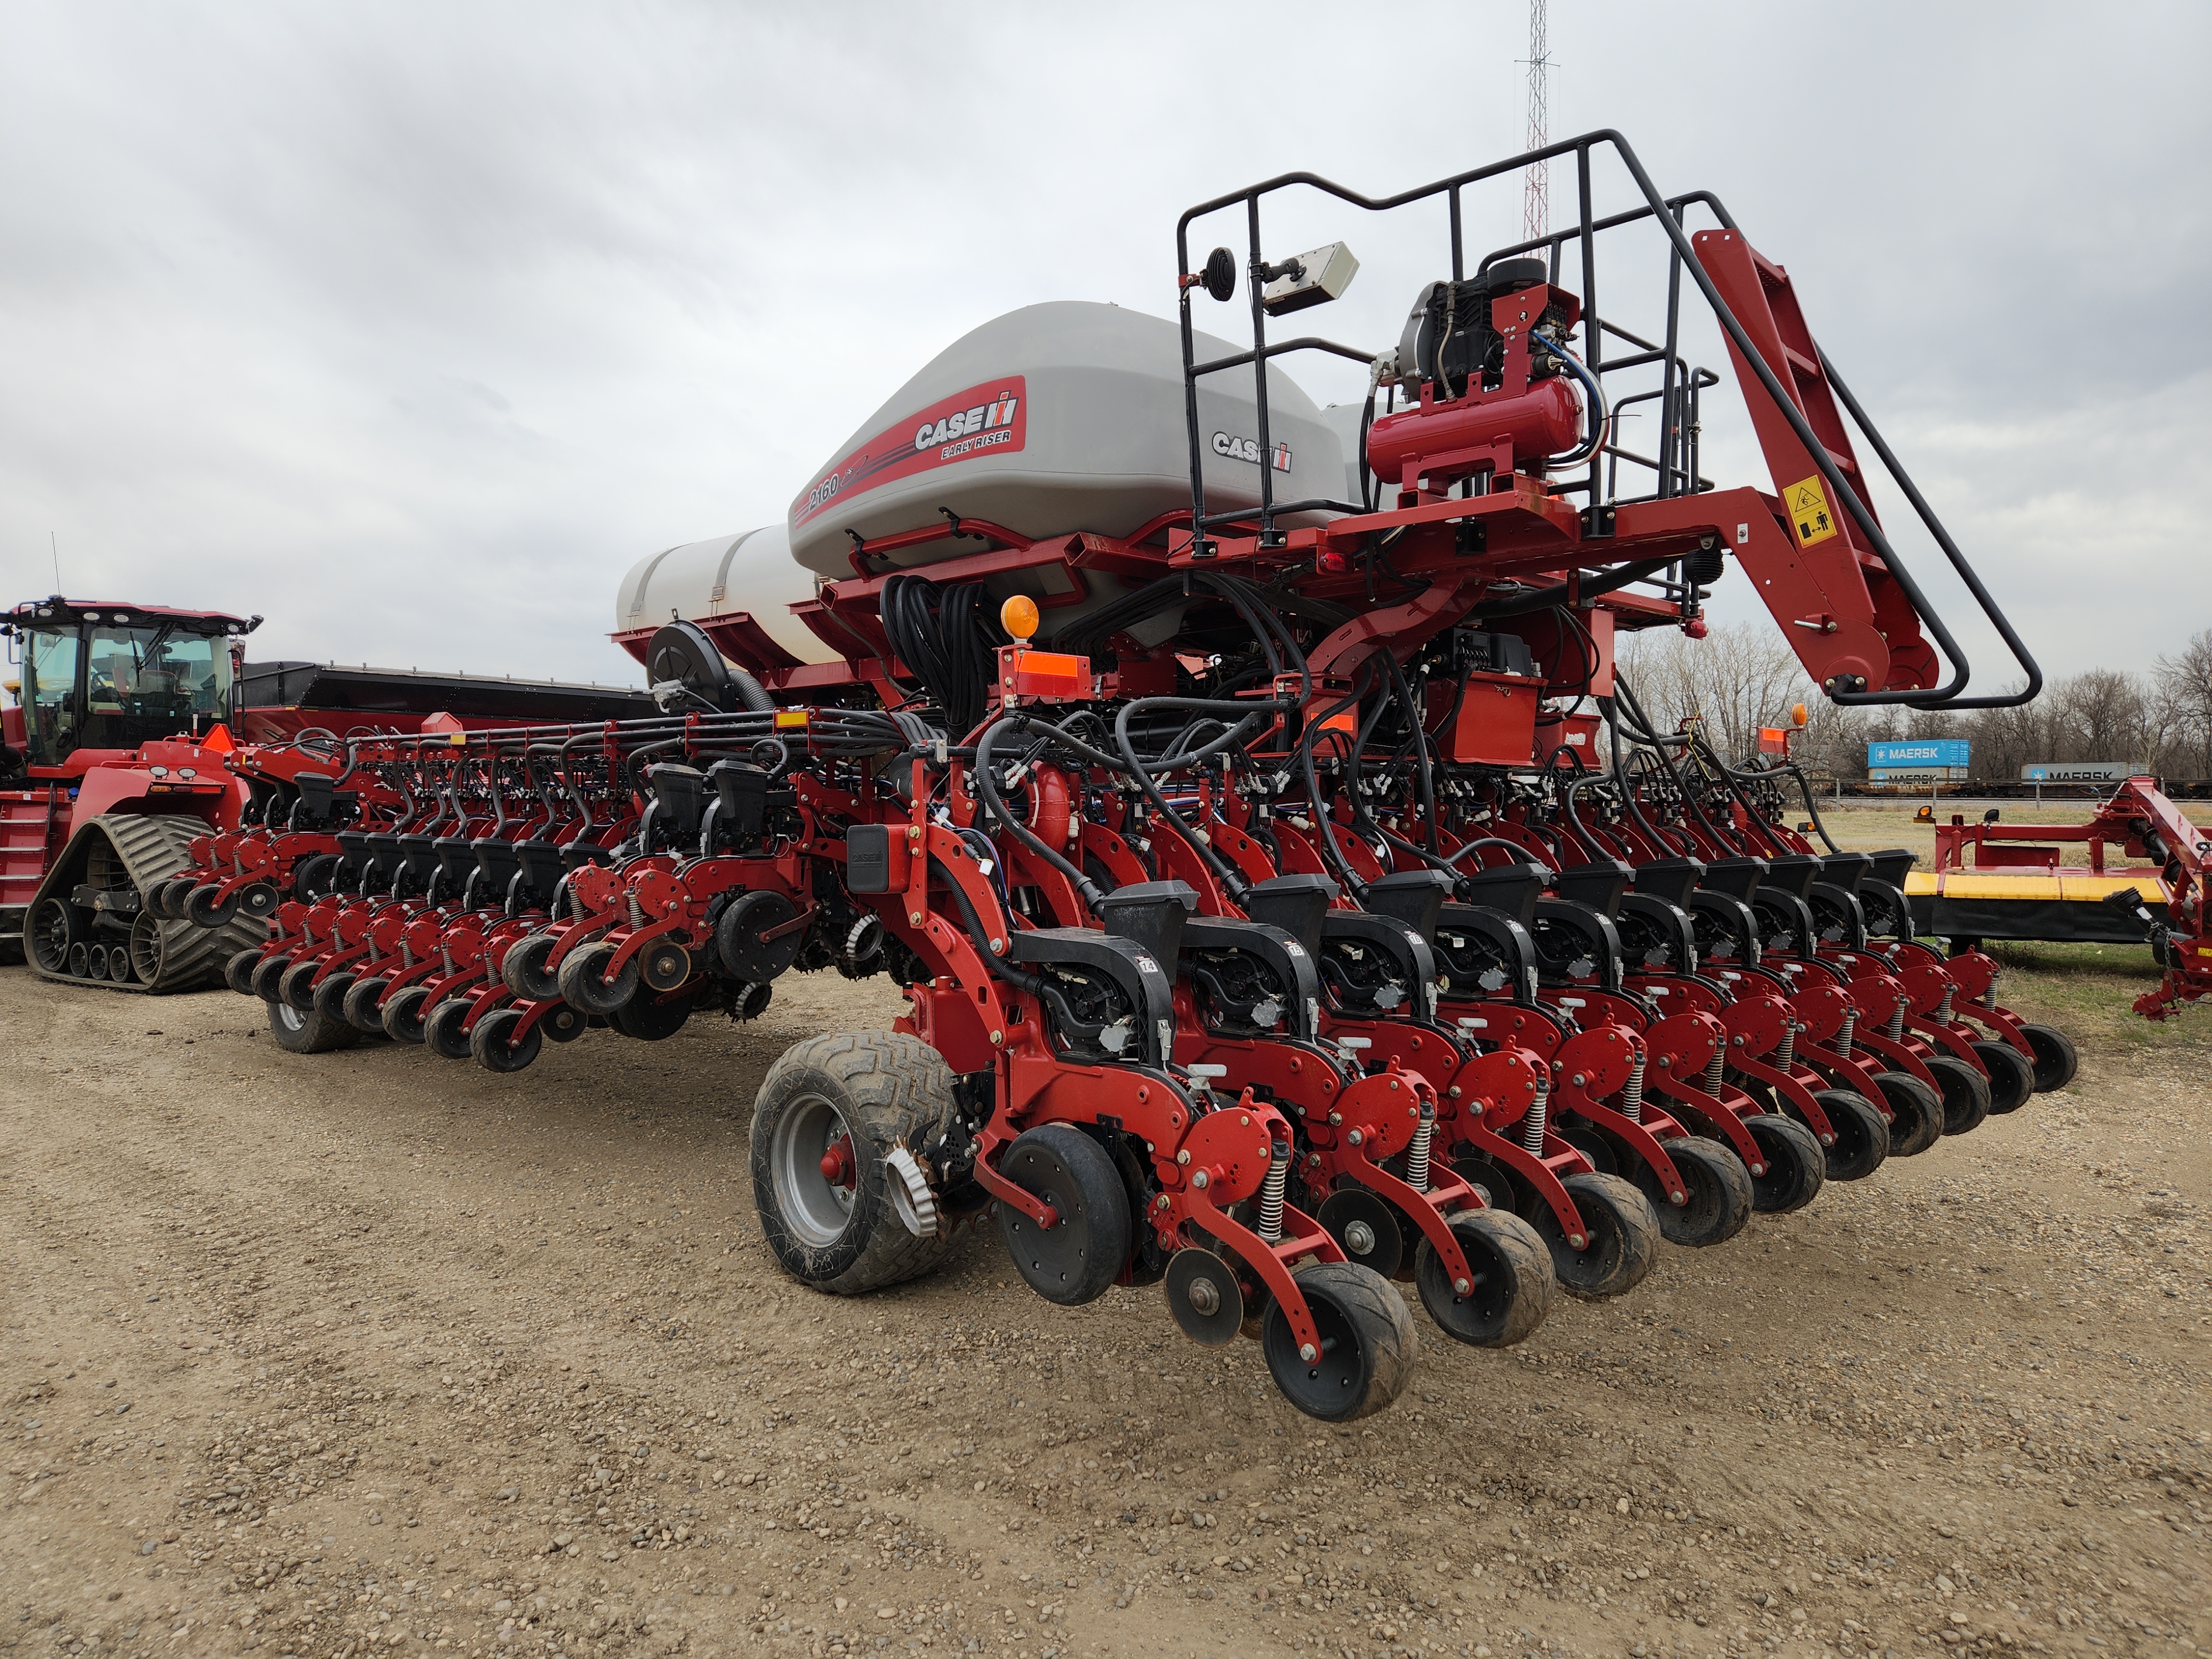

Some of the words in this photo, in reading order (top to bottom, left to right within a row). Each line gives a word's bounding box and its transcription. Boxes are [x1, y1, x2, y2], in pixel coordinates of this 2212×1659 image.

[915, 405, 986, 451] CASE
[941, 439, 975, 460] EARLY
[974, 430, 1011, 450] RISER
[1212, 432, 1272, 463] CAS
[808, 473, 839, 512] 2160
[1889, 747, 1938, 759] MAERSK
[1888, 774, 1937, 784] MAERSK
[1290, 946, 1301, 954] 15
[1142, 962, 1155, 971] 14
